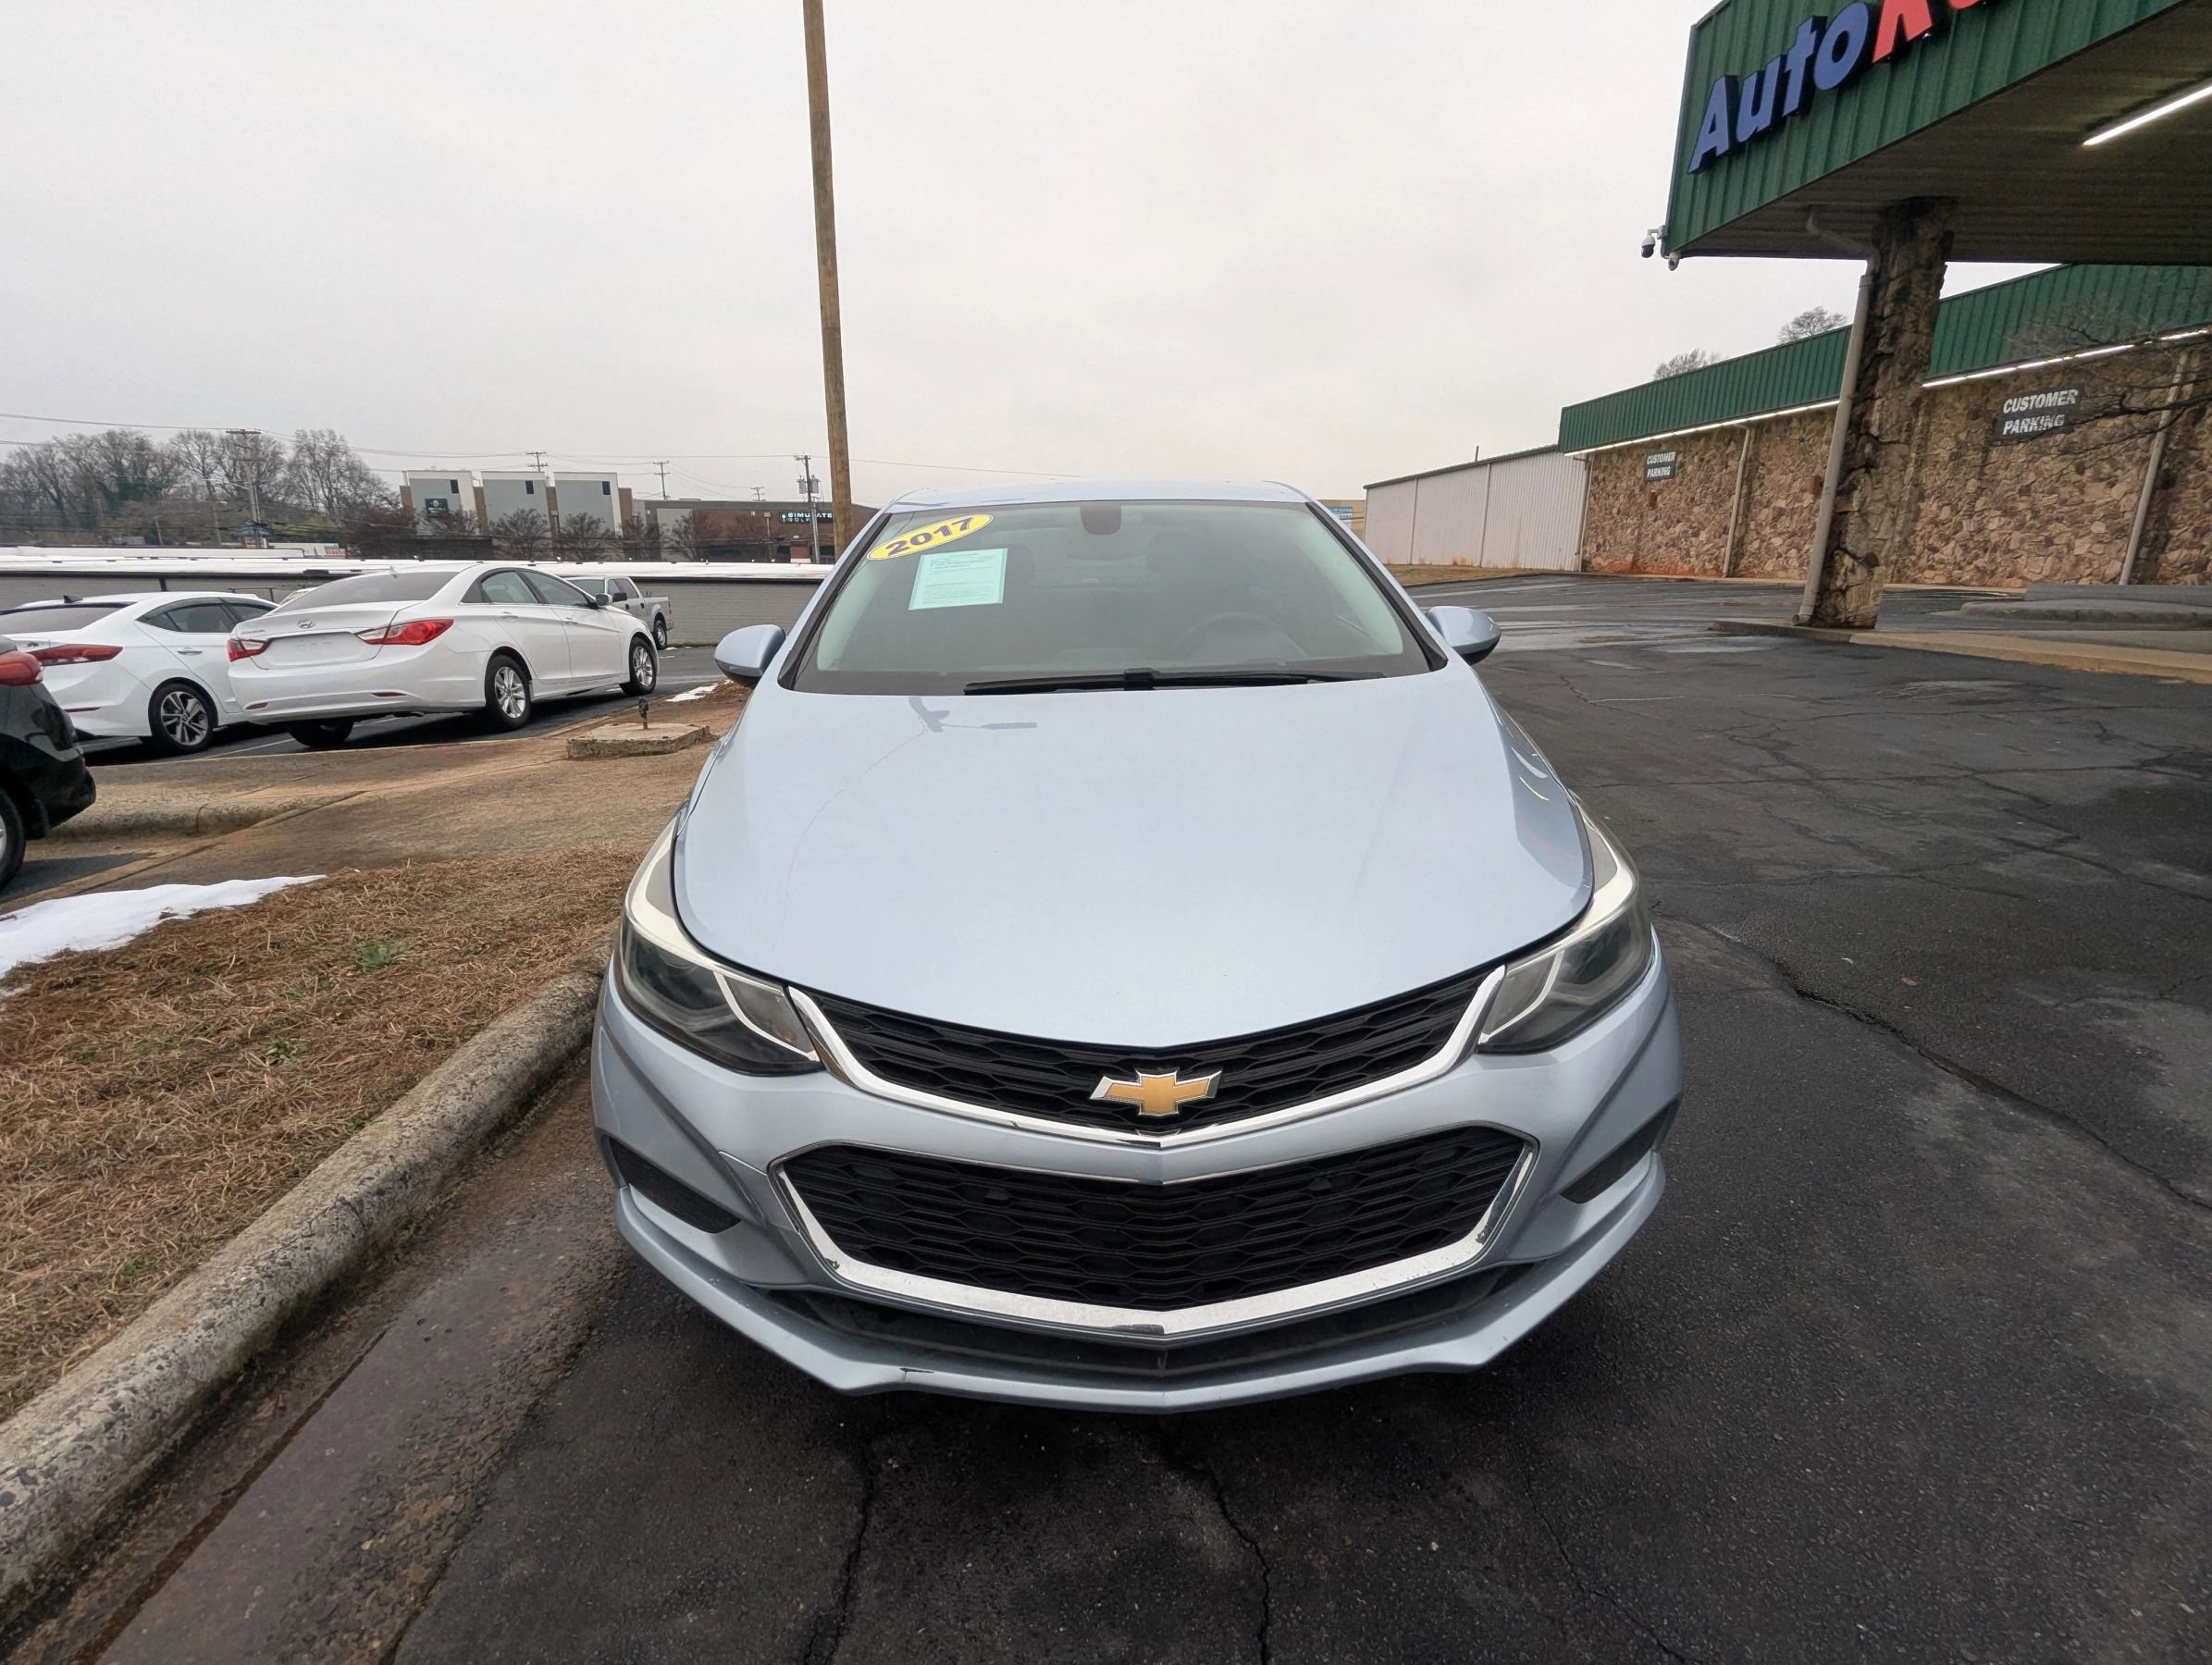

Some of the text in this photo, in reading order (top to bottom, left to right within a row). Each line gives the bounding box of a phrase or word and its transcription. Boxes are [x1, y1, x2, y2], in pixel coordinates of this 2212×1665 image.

[2003, 389, 2079, 413] CUSTOMER
[2002, 414, 2066, 435] PARKING
[1647, 451, 1676, 465] CUSTOMER
[1647, 466, 1671, 478] PARKING
[885, 517, 975, 556] 2017
